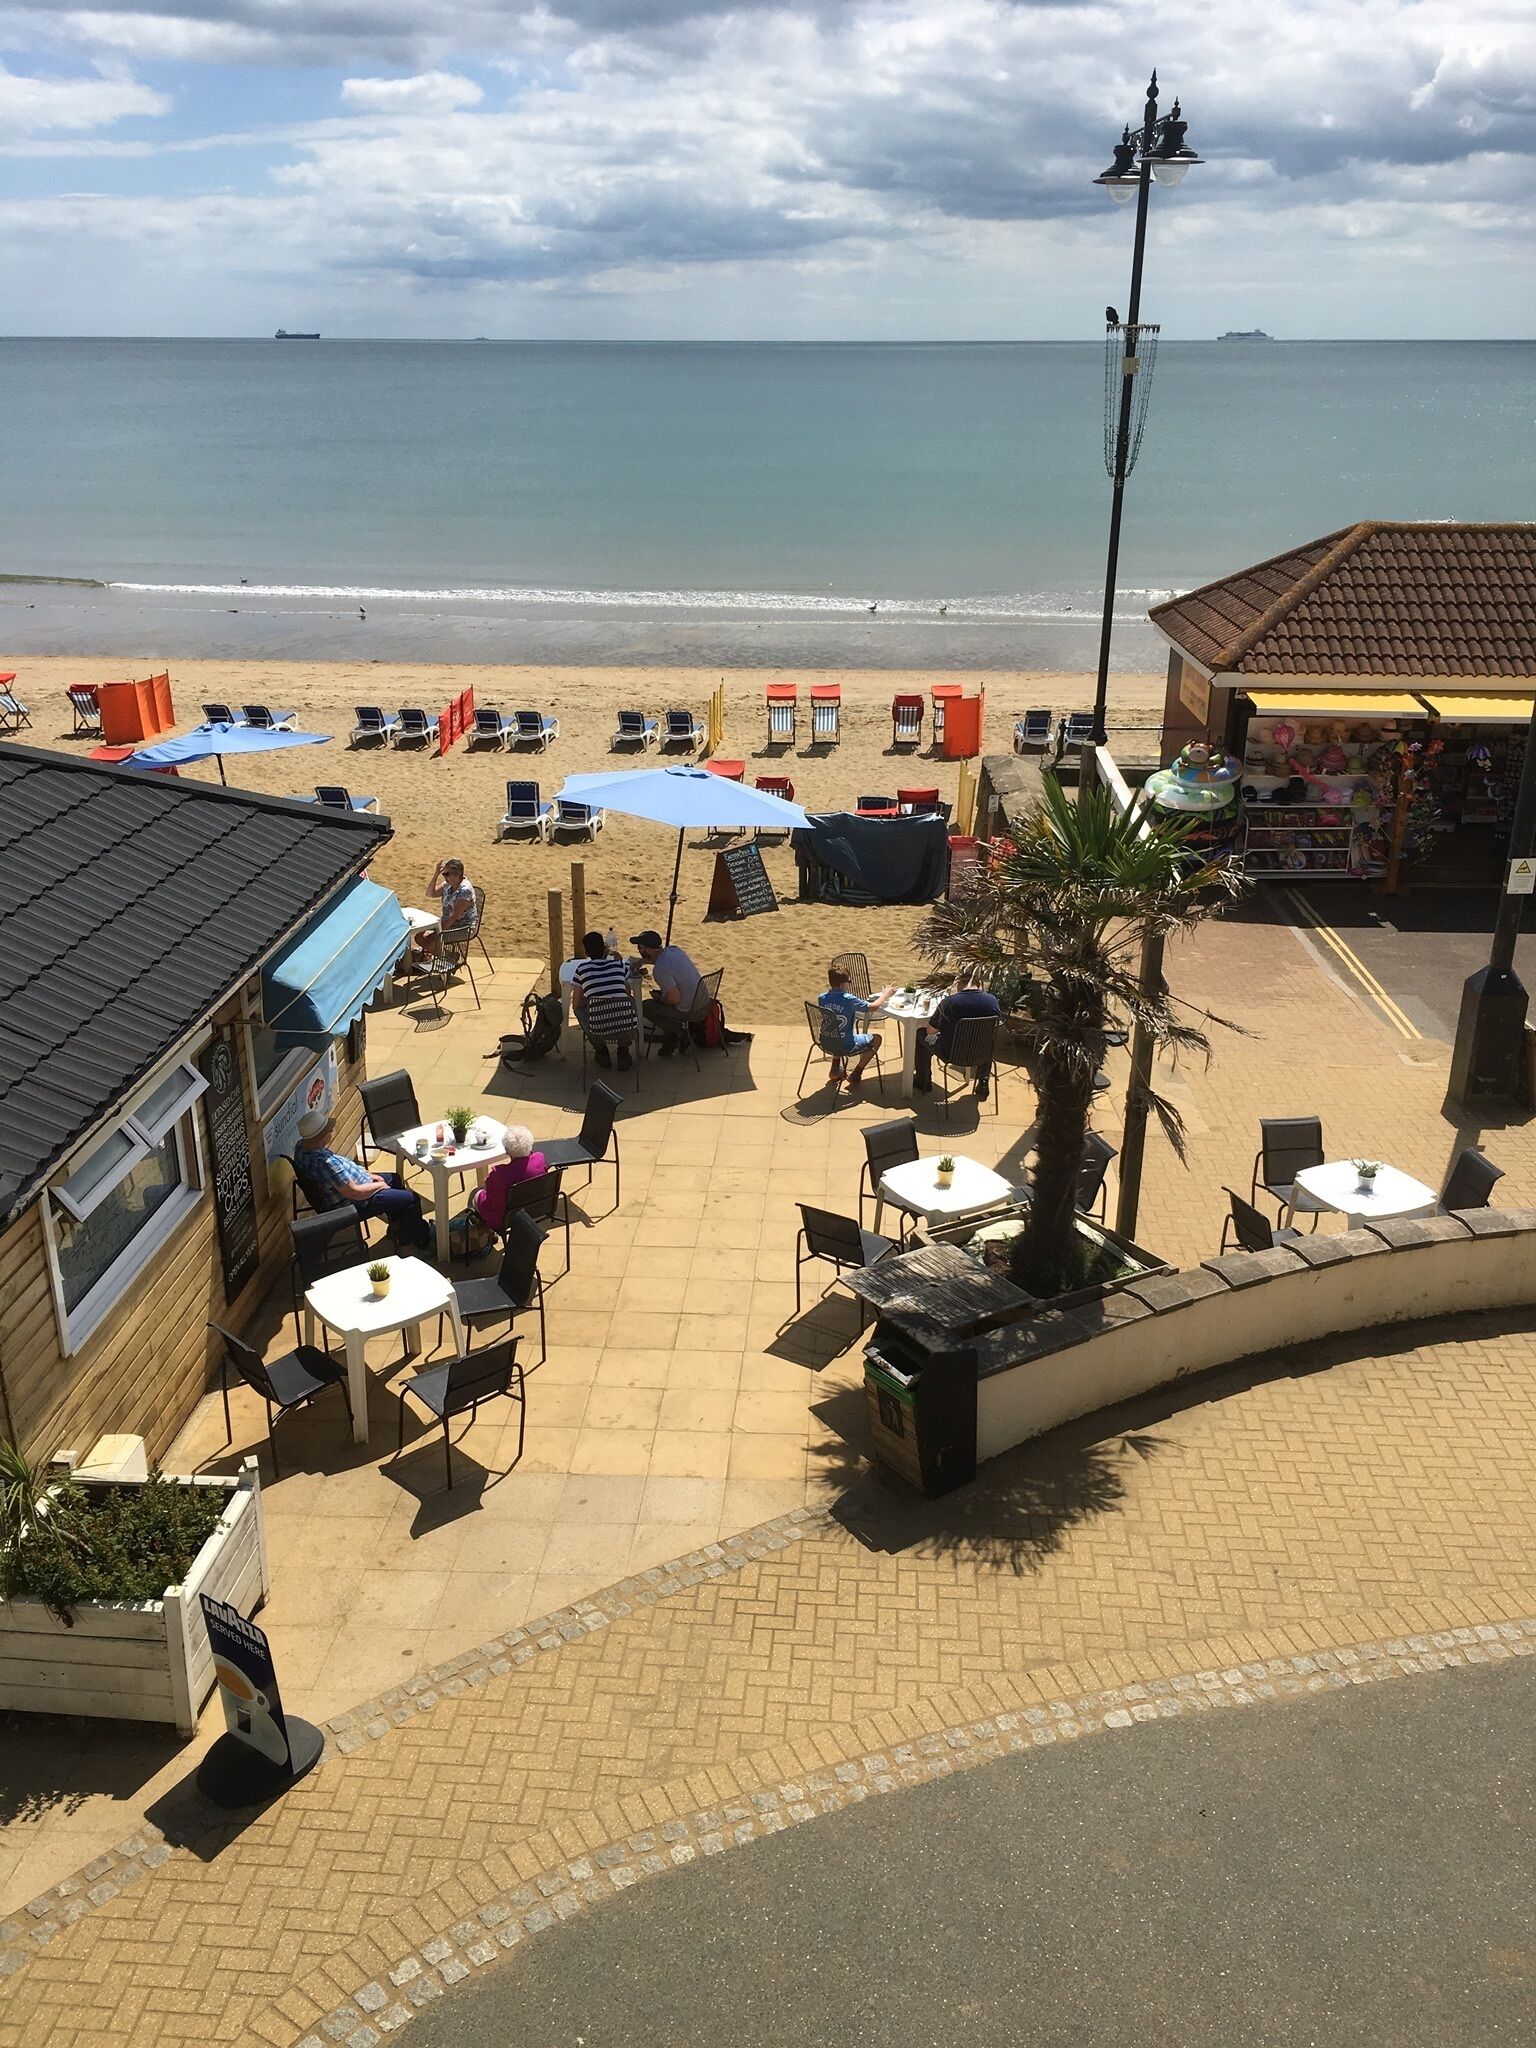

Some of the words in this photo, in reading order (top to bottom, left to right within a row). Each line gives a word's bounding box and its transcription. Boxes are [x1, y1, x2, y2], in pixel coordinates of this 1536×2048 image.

[215, 1120, 227, 1140] INSIDE
[227, 1102, 242, 1126] SEATING
[216, 1130, 229, 1150] FRESH
[229, 1111, 244, 1135] COFFEE
[216, 1138, 249, 1187] SANDWICHES
[217, 1173, 232, 1202] HOT
[232, 1151, 250, 1183] FOOD
[223, 1204, 236, 1228] BEERS
[239, 1185, 252, 1206] WINES
[224, 1172, 249, 1213] CHIPS
[228, 1263, 240, 1282] OPEN
[203, 1597, 267, 1648] LAVAZZA
[210, 1619, 242, 1645] SERVED
[243, 1639, 267, 1661] HERE
